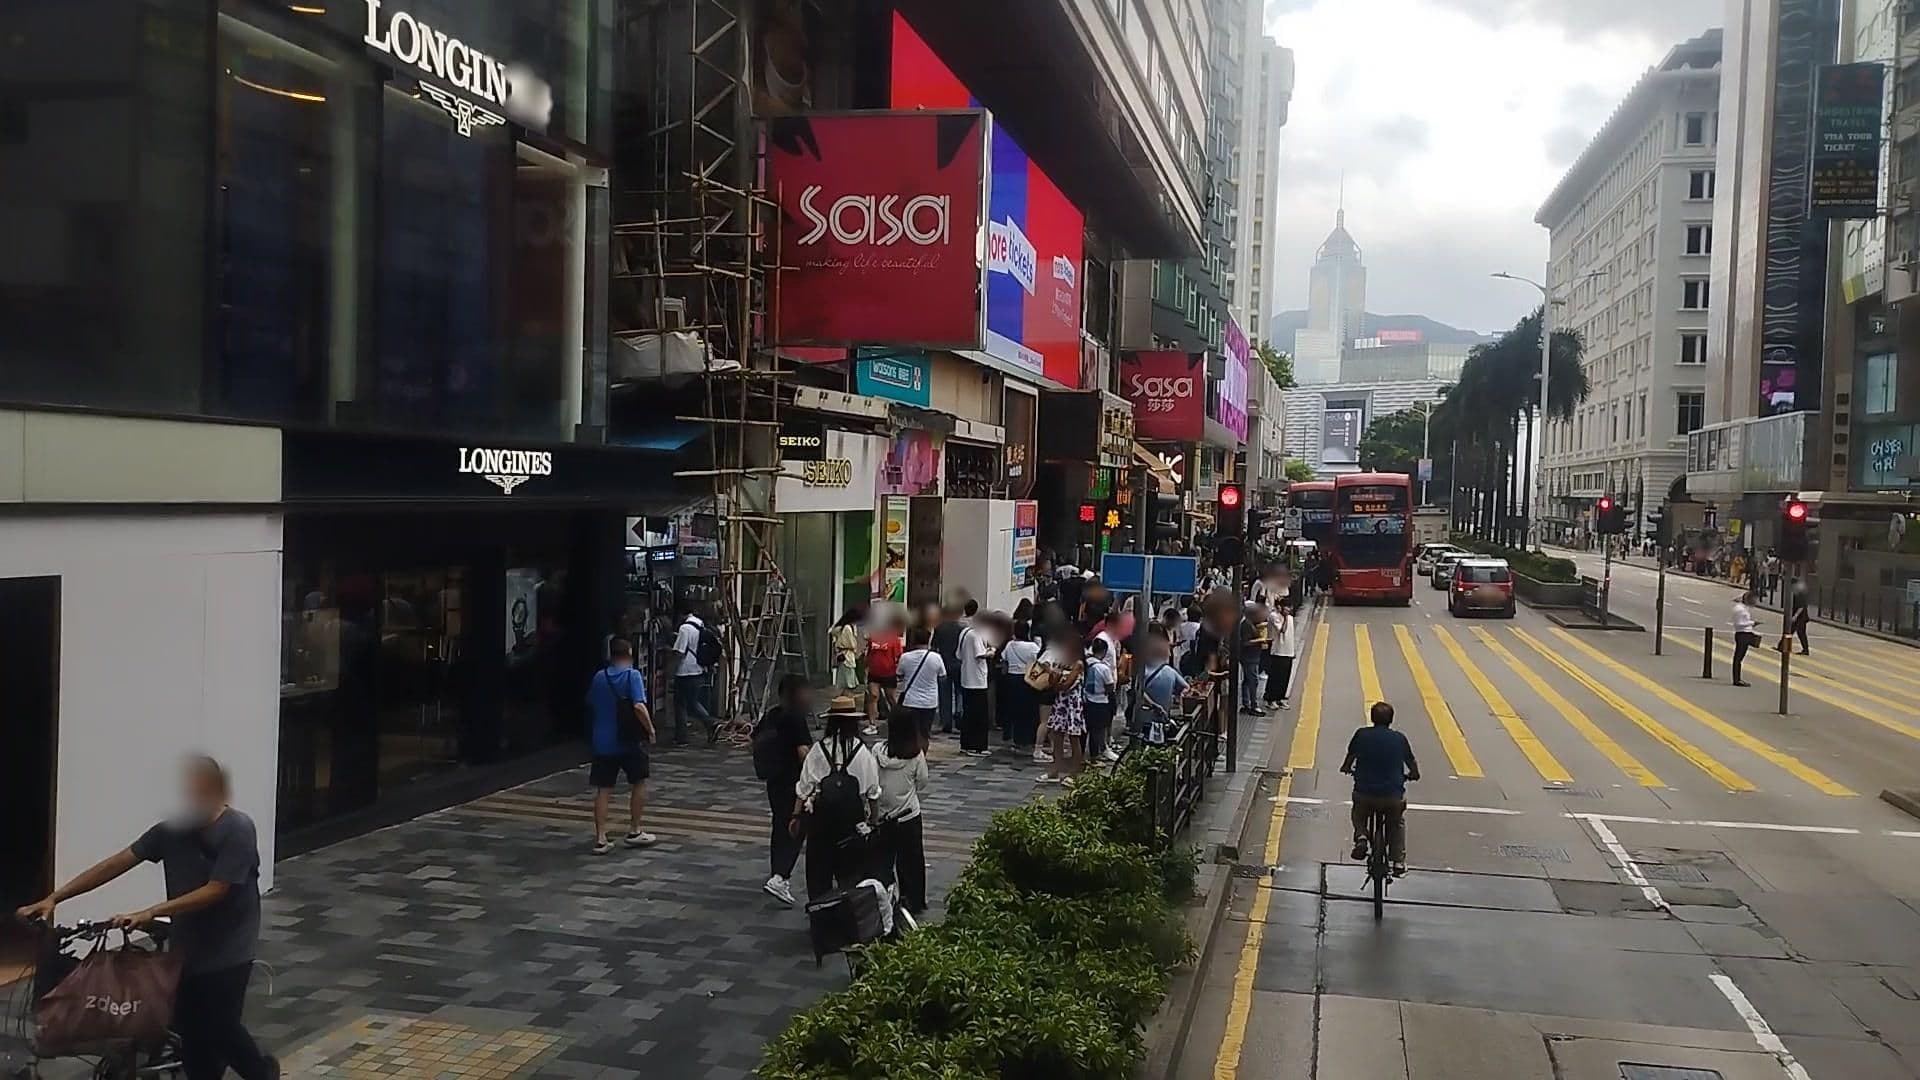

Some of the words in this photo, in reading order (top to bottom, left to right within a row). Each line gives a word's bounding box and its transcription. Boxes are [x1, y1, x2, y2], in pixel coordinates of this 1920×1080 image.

[364, 0, 552, 127] LONGIN
[806, 257, 849, 275] making
[1008, 231, 1034, 284] tickets
[1147, 398, 1175, 412] 莎莎
[780, 436, 820, 447] SEIKO
[459, 448, 552, 475] LONGINES
[803, 457, 853, 487] SEIKO
[85, 995, 141, 1016] zdeer
